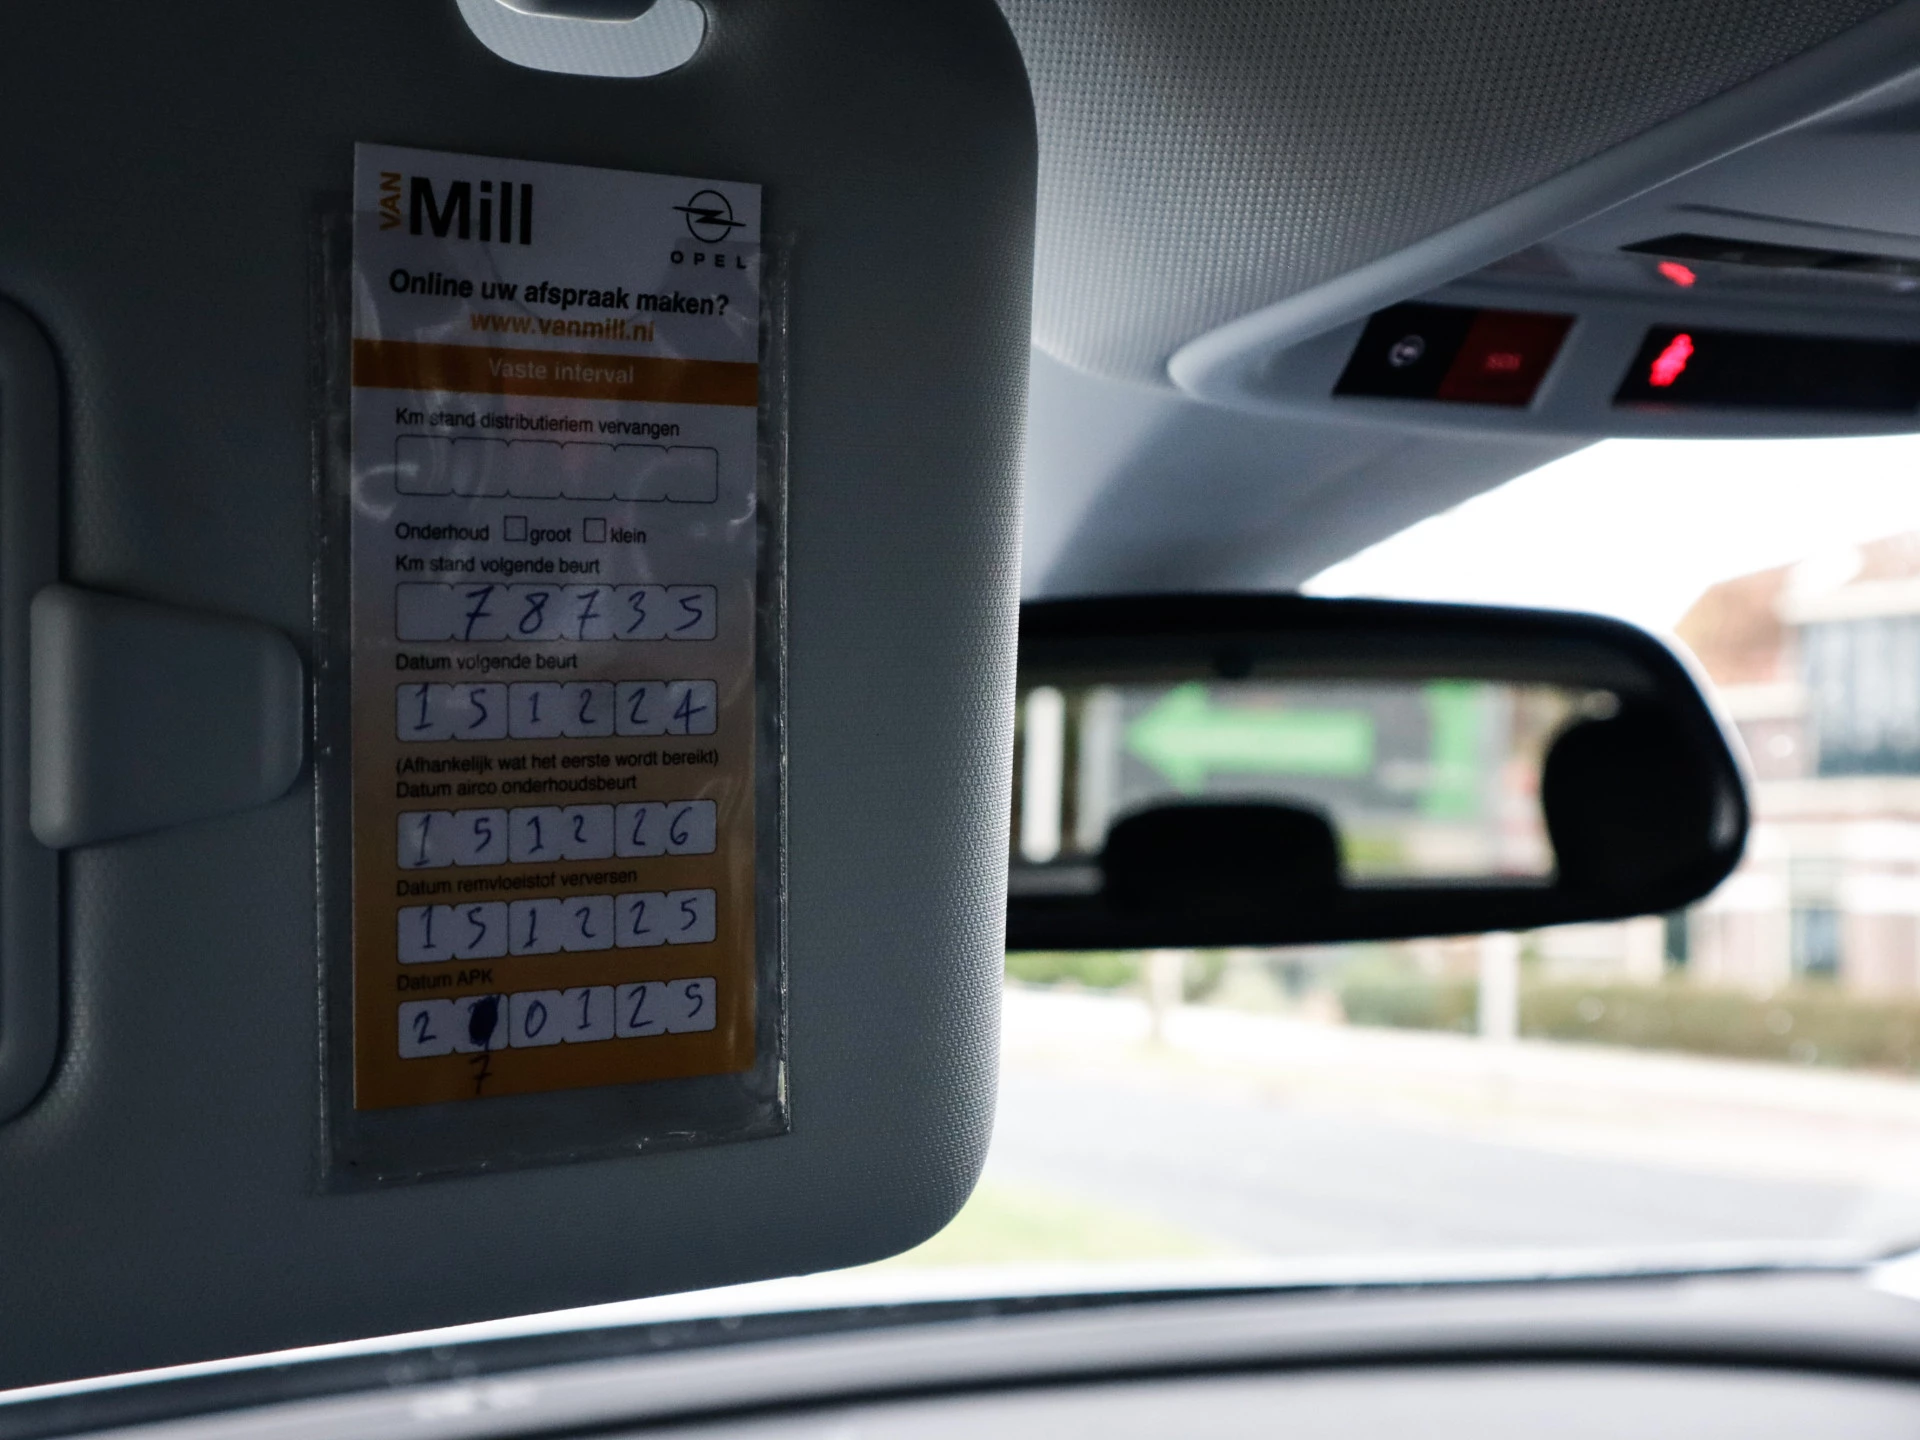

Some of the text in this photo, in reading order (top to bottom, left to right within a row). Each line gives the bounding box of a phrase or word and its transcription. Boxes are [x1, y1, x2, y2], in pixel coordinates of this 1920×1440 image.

[379, 172, 533, 246] VAN Mill
[670, 250, 747, 269] OPEL
[389, 269, 730, 317] Online uw afspraak maken?
[470, 312, 656, 343] www.vanmill.nl
[488, 357, 634, 384] Vaste interval
[395, 407, 680, 440] Km stand distributieriem vervangen
[395, 522, 490, 542] Onderhoud
[529, 527, 572, 546] groot
[610, 526, 647, 544] klein
[396, 555, 601, 576] Km stand volgende beurt
[396, 652, 577, 673] Datum volgende beurt
[396, 748, 719, 775] (Afhankelijk wat het eerste wordt bereikt)
[396, 775, 638, 799] Datum airco onderhoudsbeurt
[396, 869, 638, 897] Datum remvloeistof verversen
[396, 968, 493, 992] Datum APK
